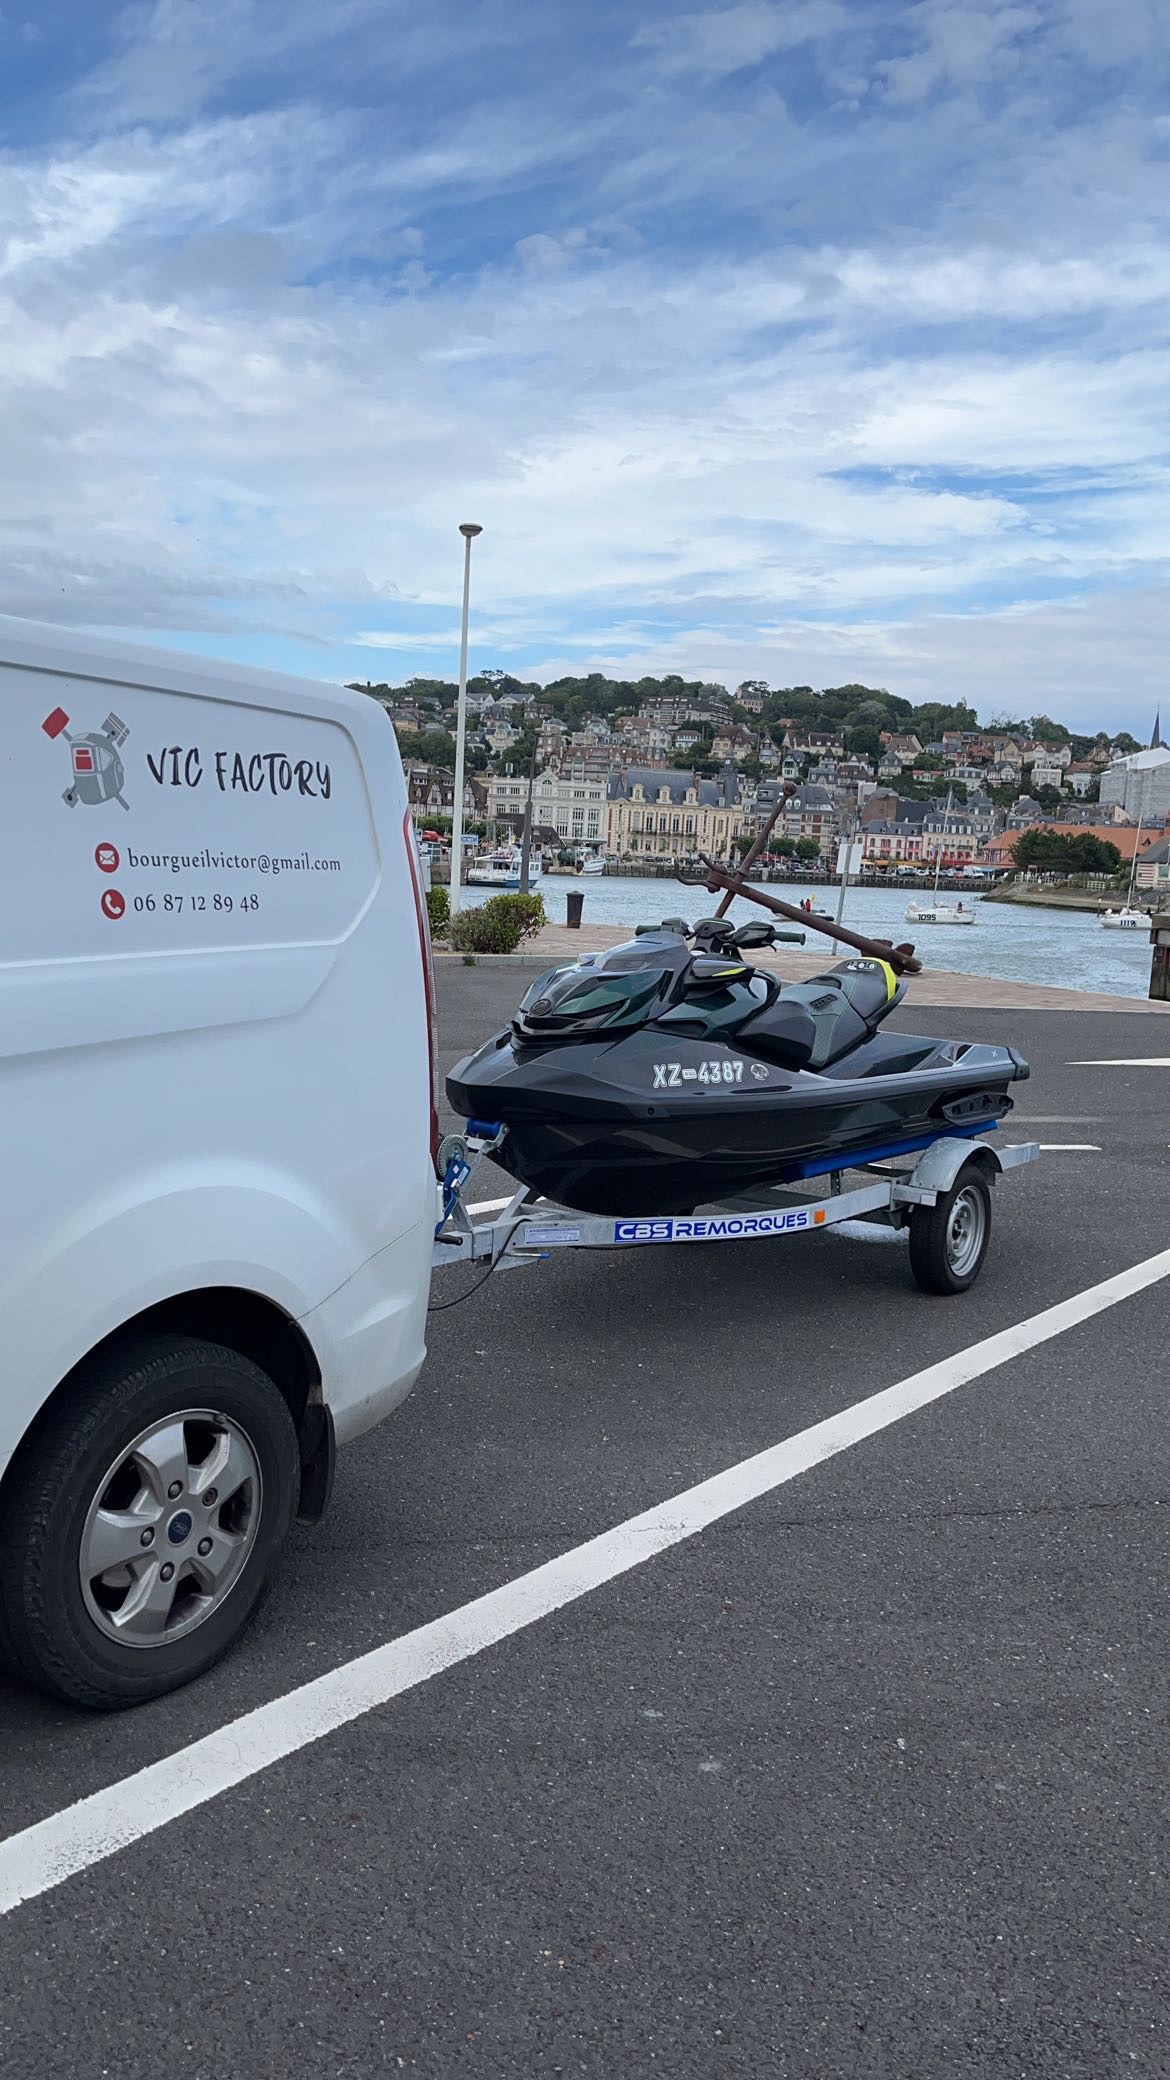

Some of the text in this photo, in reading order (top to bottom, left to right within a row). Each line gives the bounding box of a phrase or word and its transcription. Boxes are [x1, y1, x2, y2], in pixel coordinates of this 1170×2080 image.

[146, 745, 332, 800] VIC FACTORY
[127, 847, 342, 875] bourgueilvictor@gmail.com
[133, 893, 260, 914] 06 87 12 89 48
[917, 913, 937, 921] 1095
[618, 1211, 808, 1240] CBS REMORQUES
